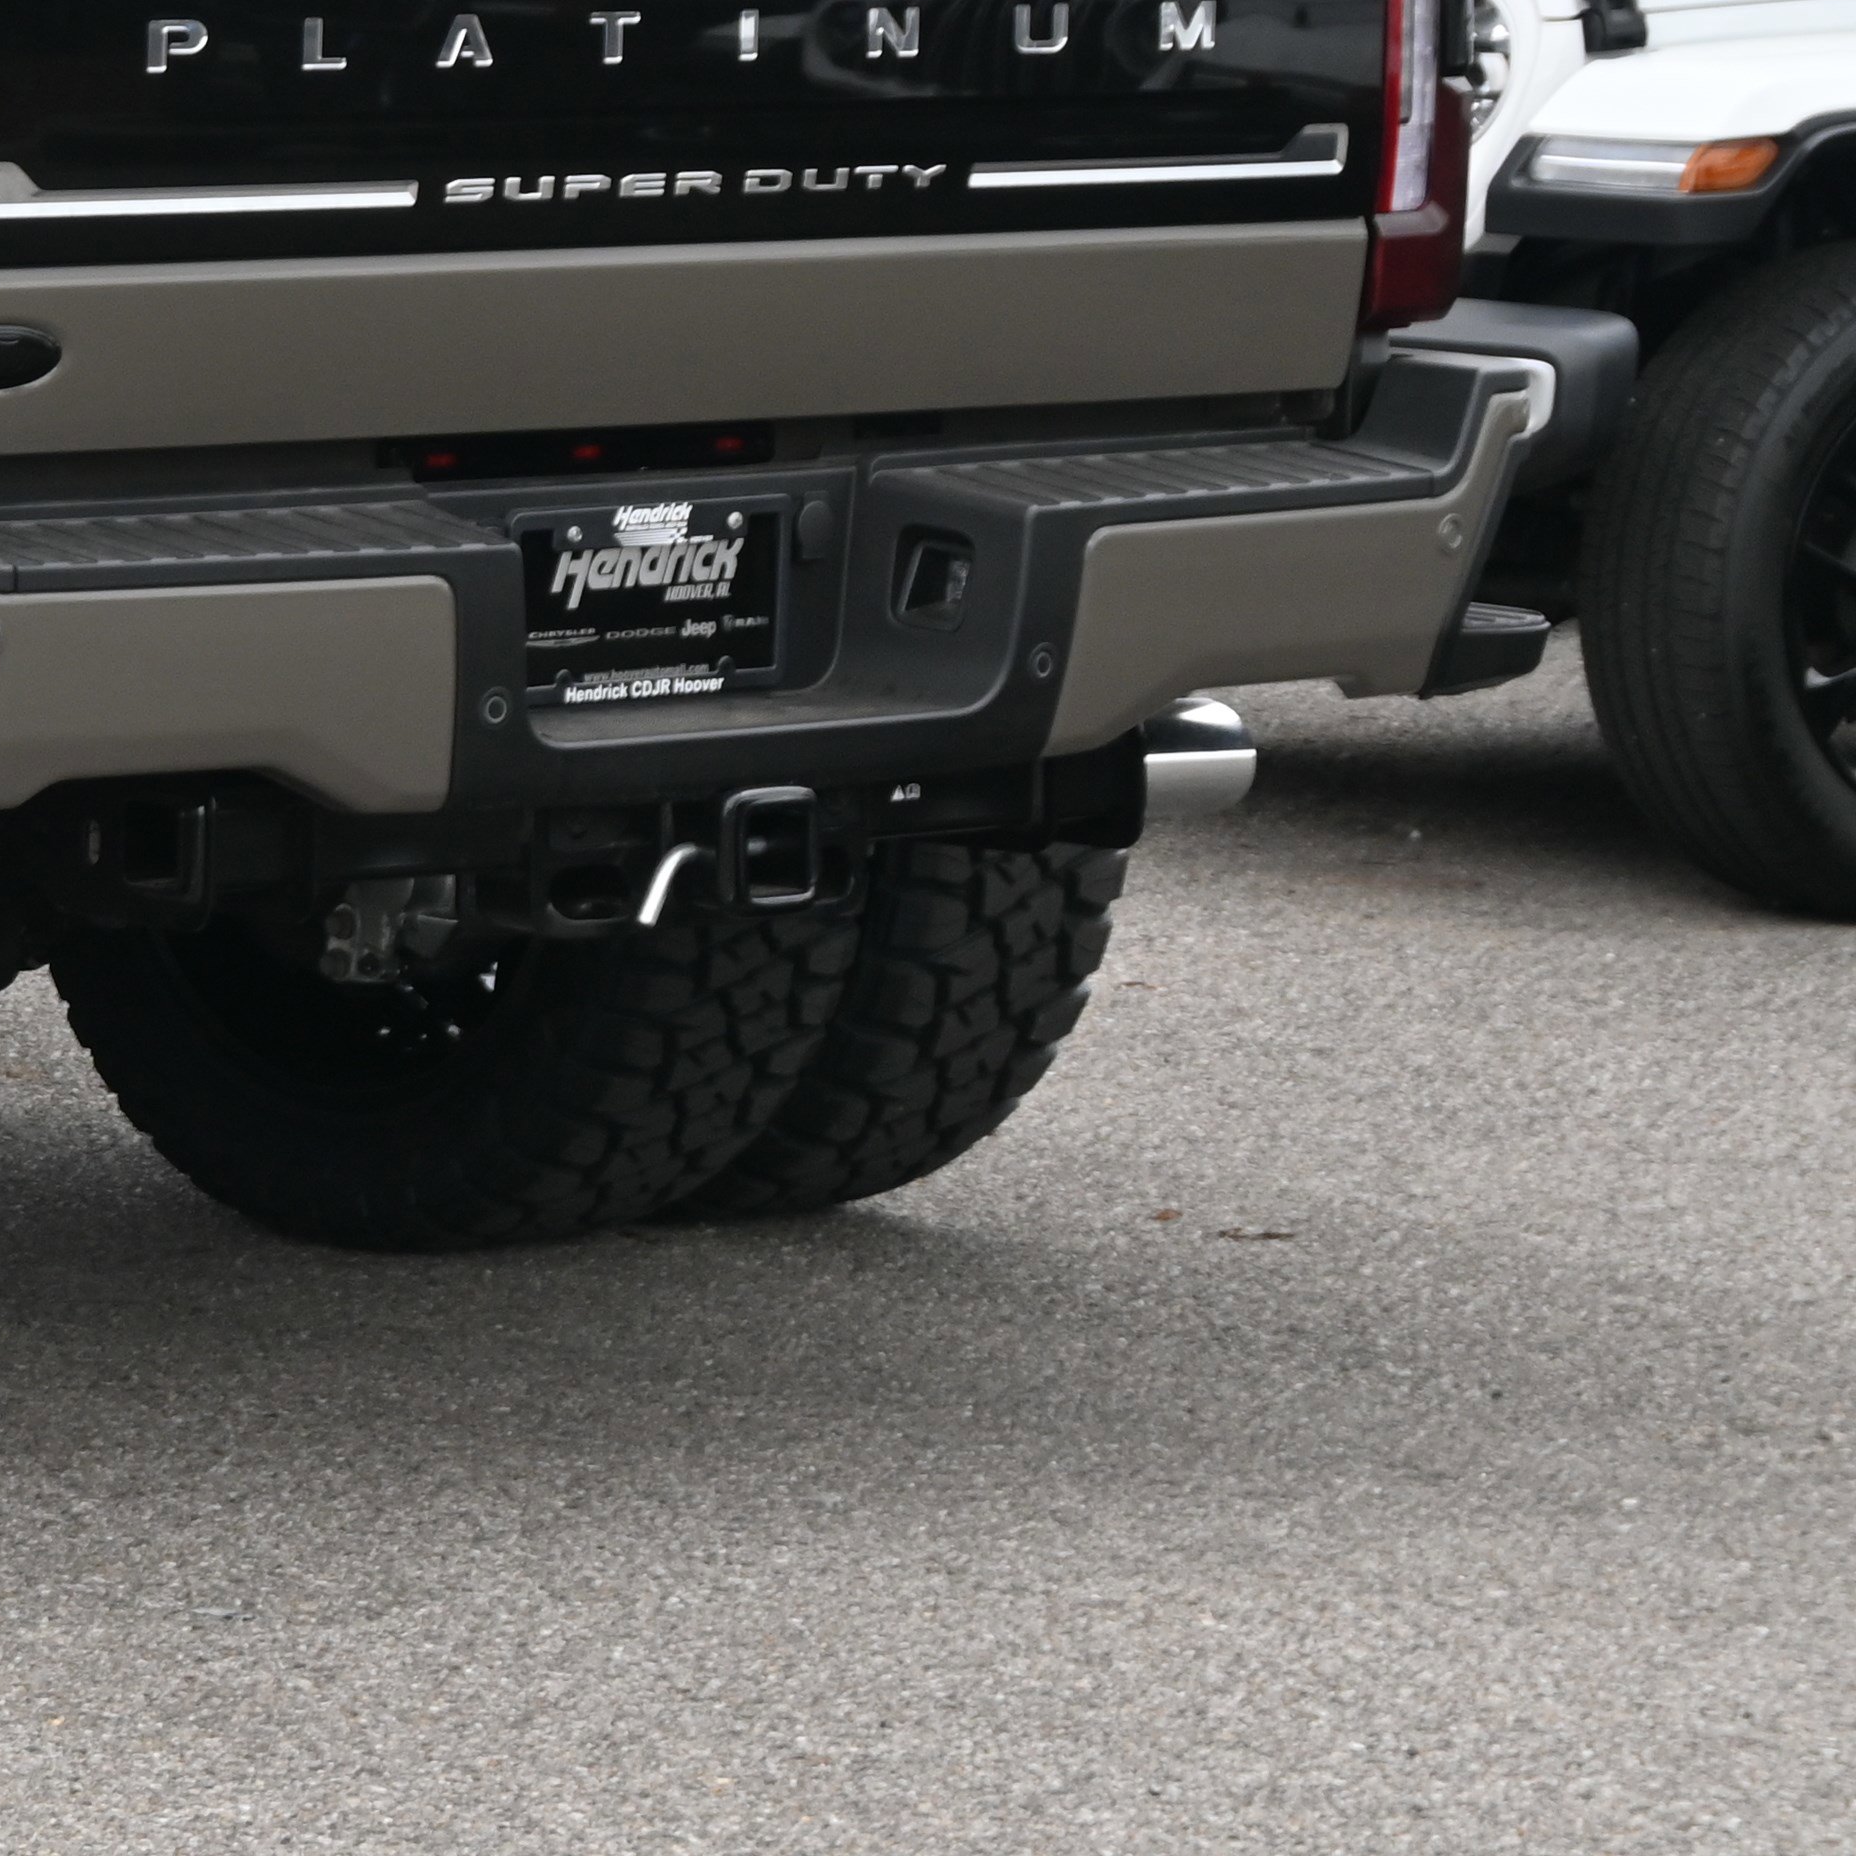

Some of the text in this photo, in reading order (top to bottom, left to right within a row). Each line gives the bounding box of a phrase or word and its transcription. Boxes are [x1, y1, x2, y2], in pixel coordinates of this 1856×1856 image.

[442, 163, 948, 204] SUPER DUTY
[612, 501, 693, 532] Hendrick
[550, 537, 744, 611] Hendrick
[527, 627, 597, 640] CHRYSLER
[605, 626, 677, 640] DODGE
[681, 618, 718, 640] Jeep
[564, 676, 725, 705] Hendrick CDJR Hoover
